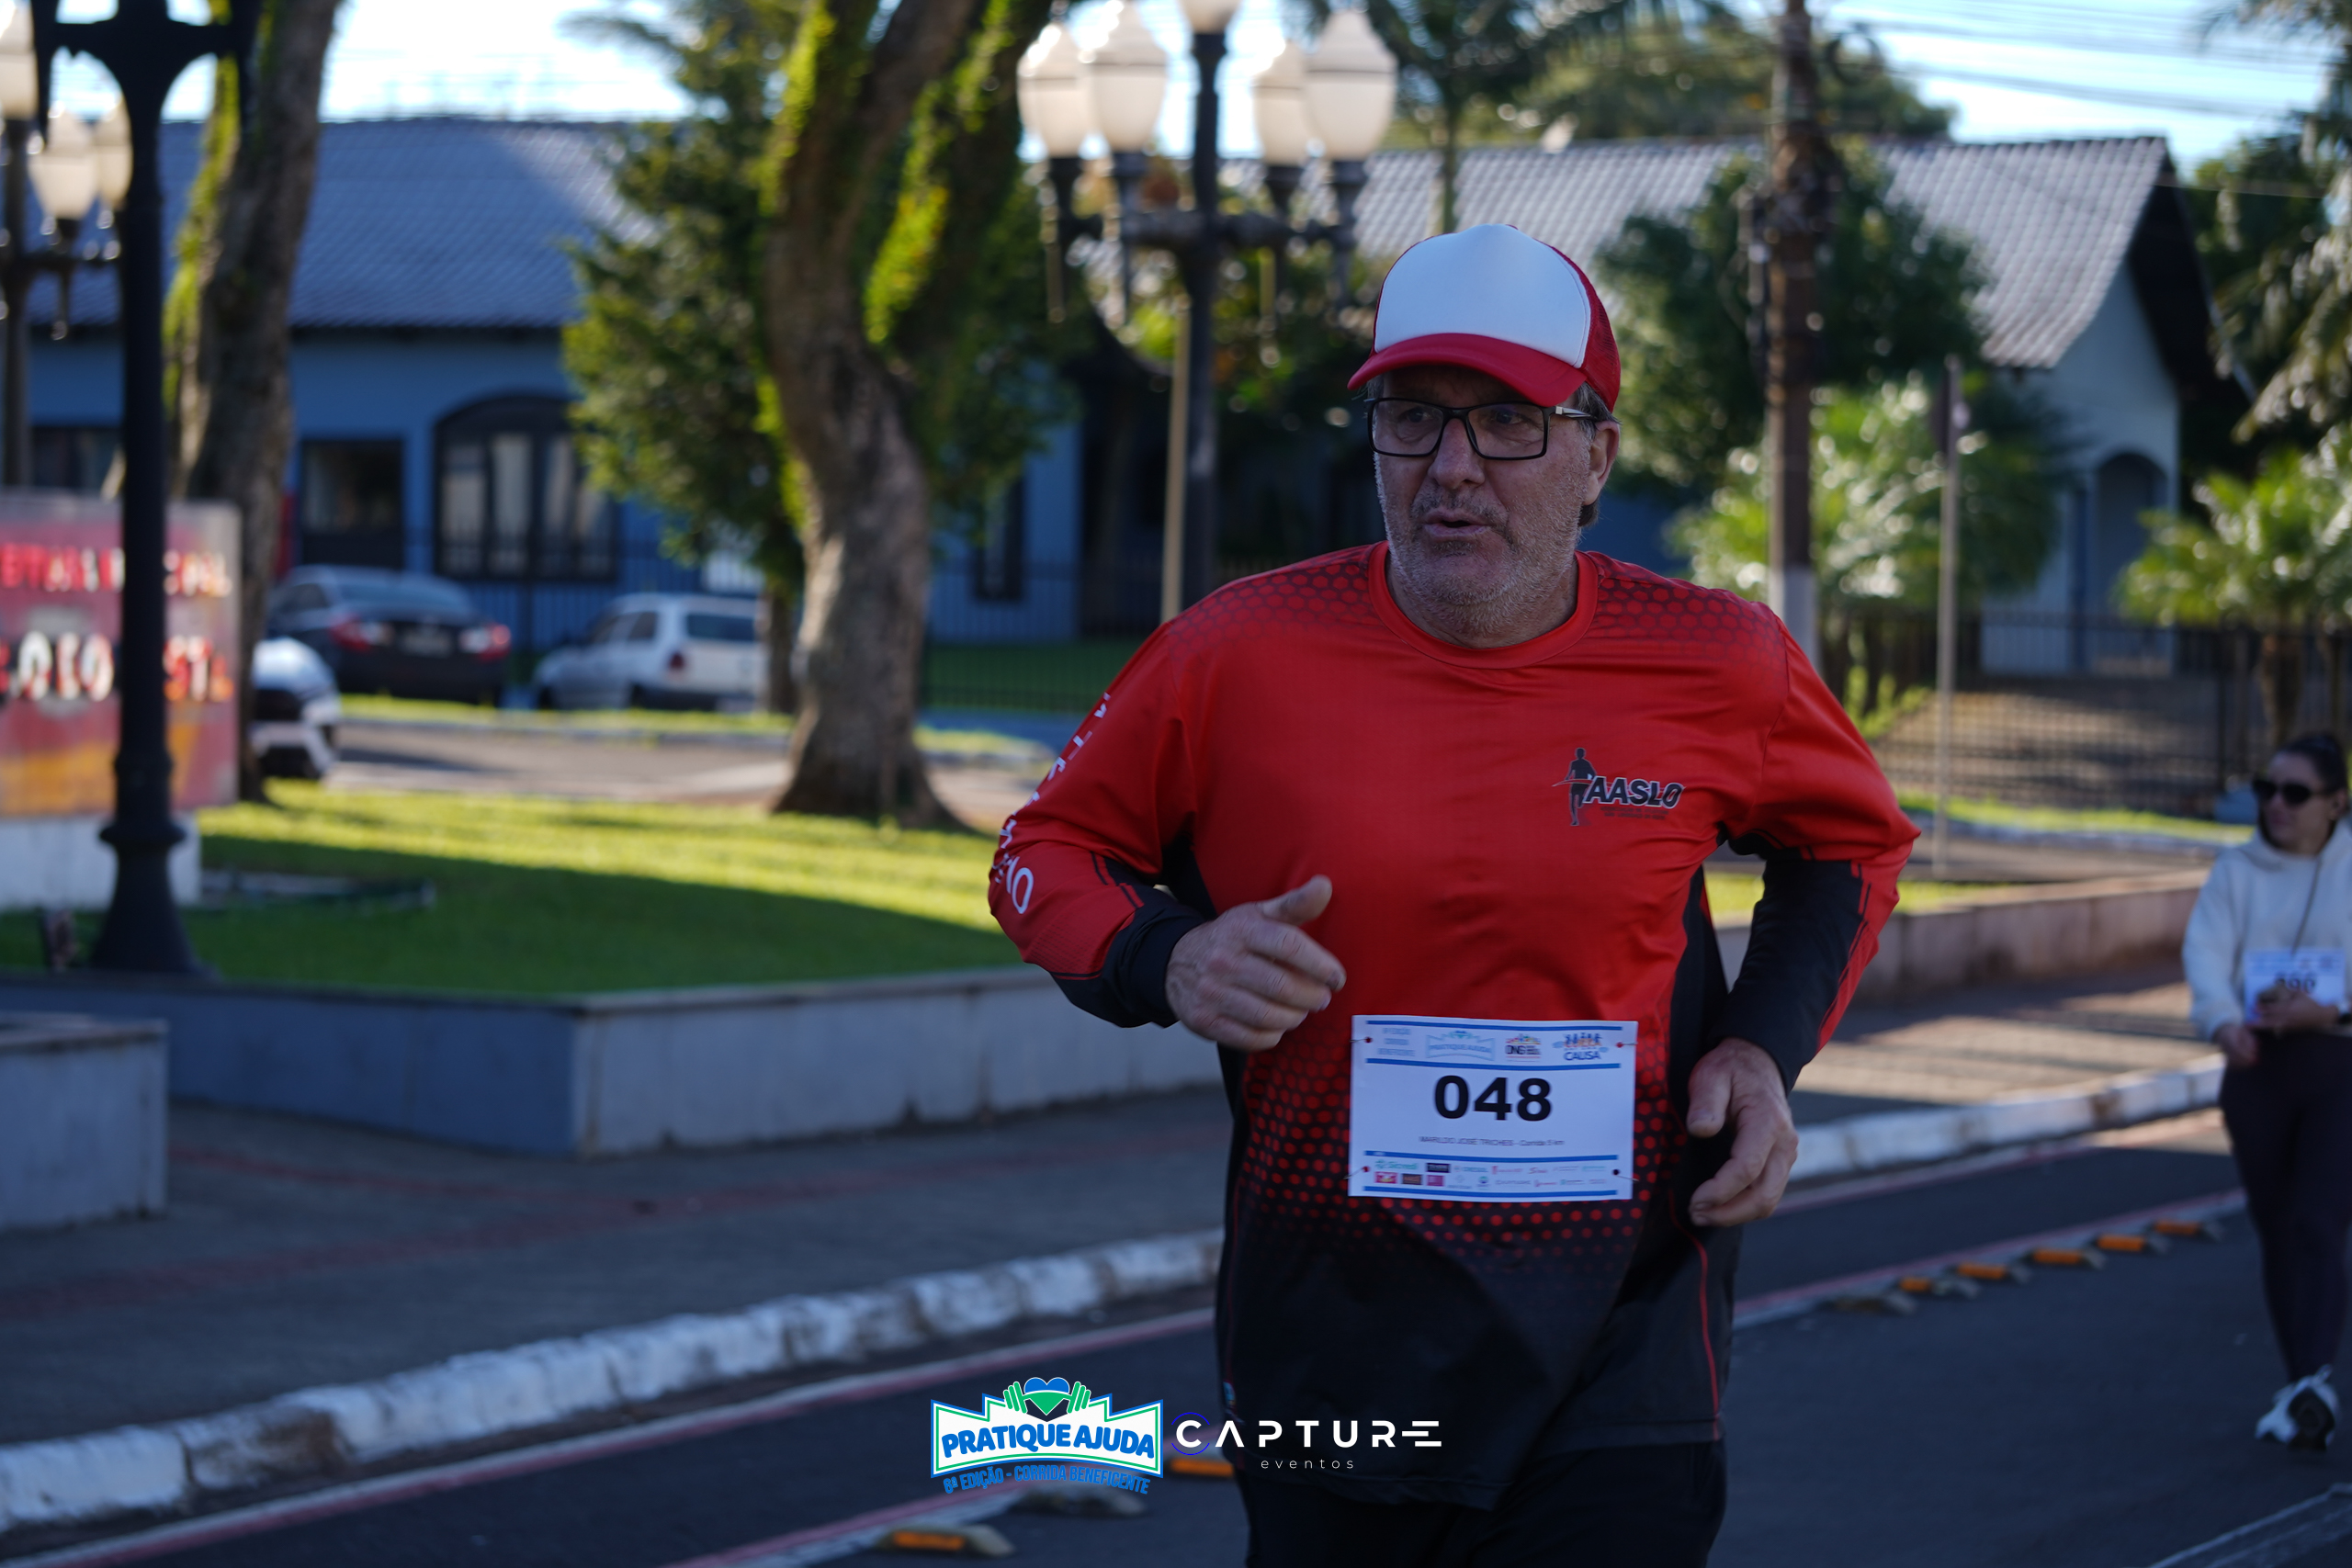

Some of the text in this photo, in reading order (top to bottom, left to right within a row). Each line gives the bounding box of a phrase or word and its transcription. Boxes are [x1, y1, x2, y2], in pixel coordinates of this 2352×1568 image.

[1582, 775, 1684, 809] AASLO
[1563, 1051, 1602, 1061] CAUSA
[1434, 1075, 1553, 1122] 048
